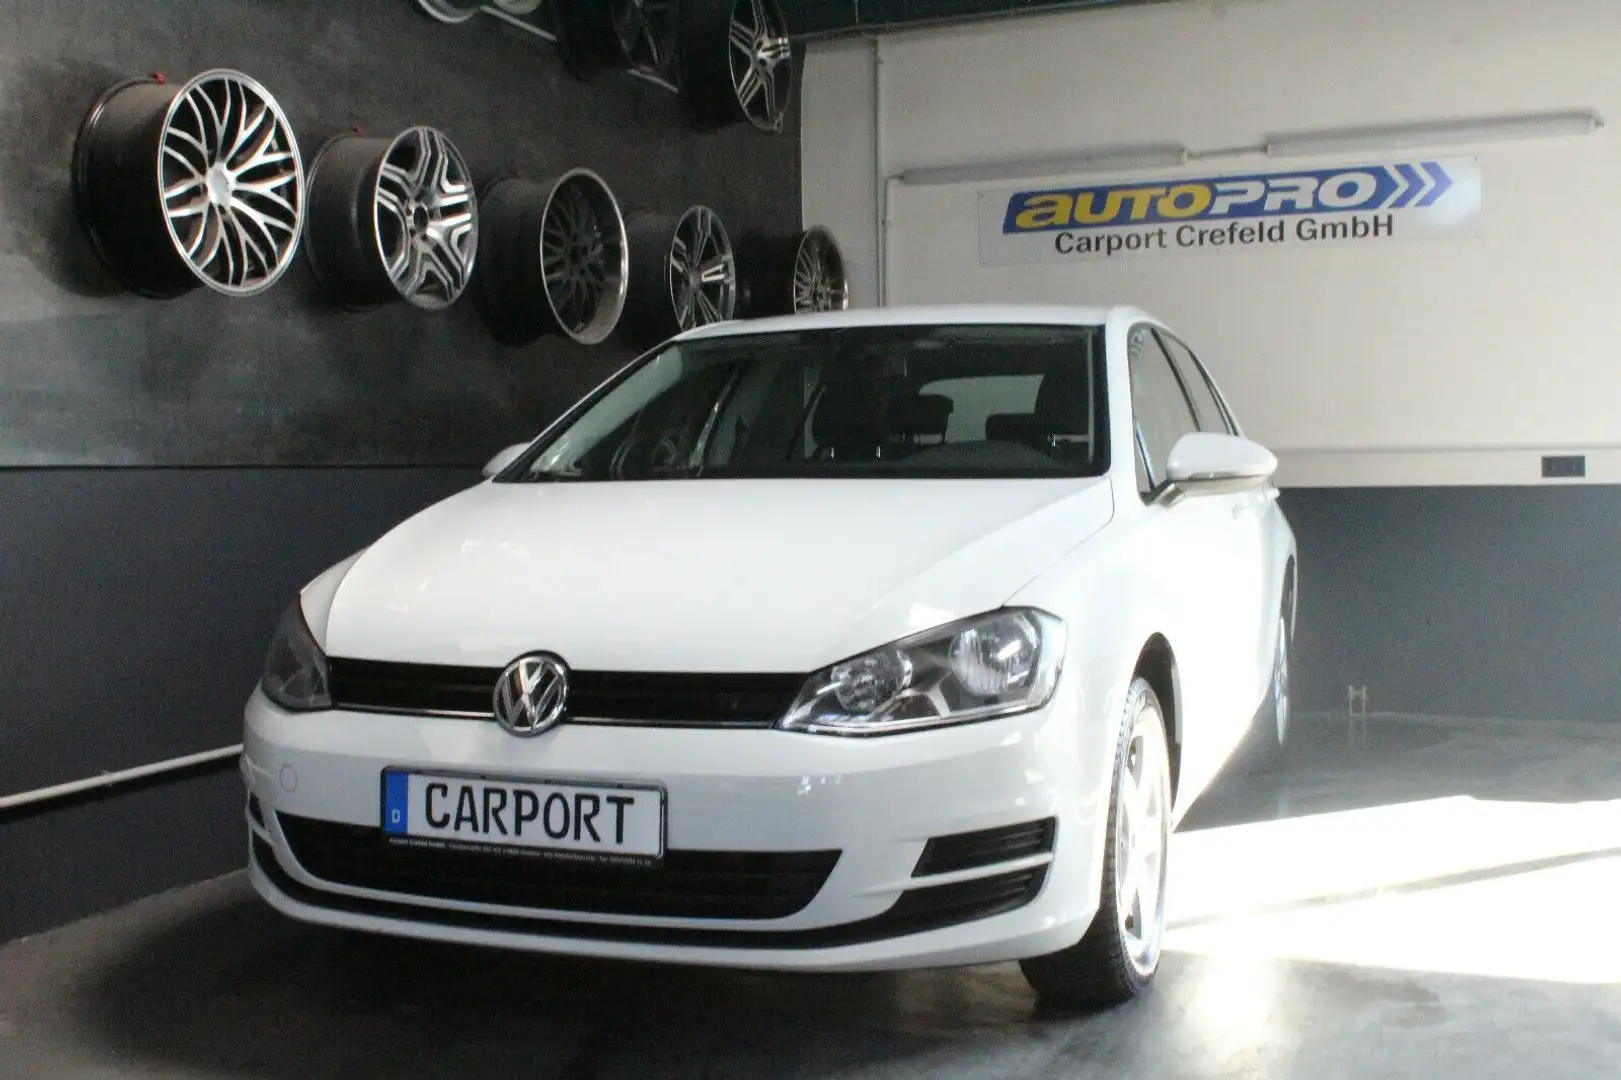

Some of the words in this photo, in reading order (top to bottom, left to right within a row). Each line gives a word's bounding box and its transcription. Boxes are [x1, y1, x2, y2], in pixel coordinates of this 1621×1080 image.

[1054, 227, 1168, 255] Carport
[1175, 220, 1285, 248] Crefeld
[1295, 213, 1394, 242] GmbH
[424, 782, 636, 844] CARPORT
